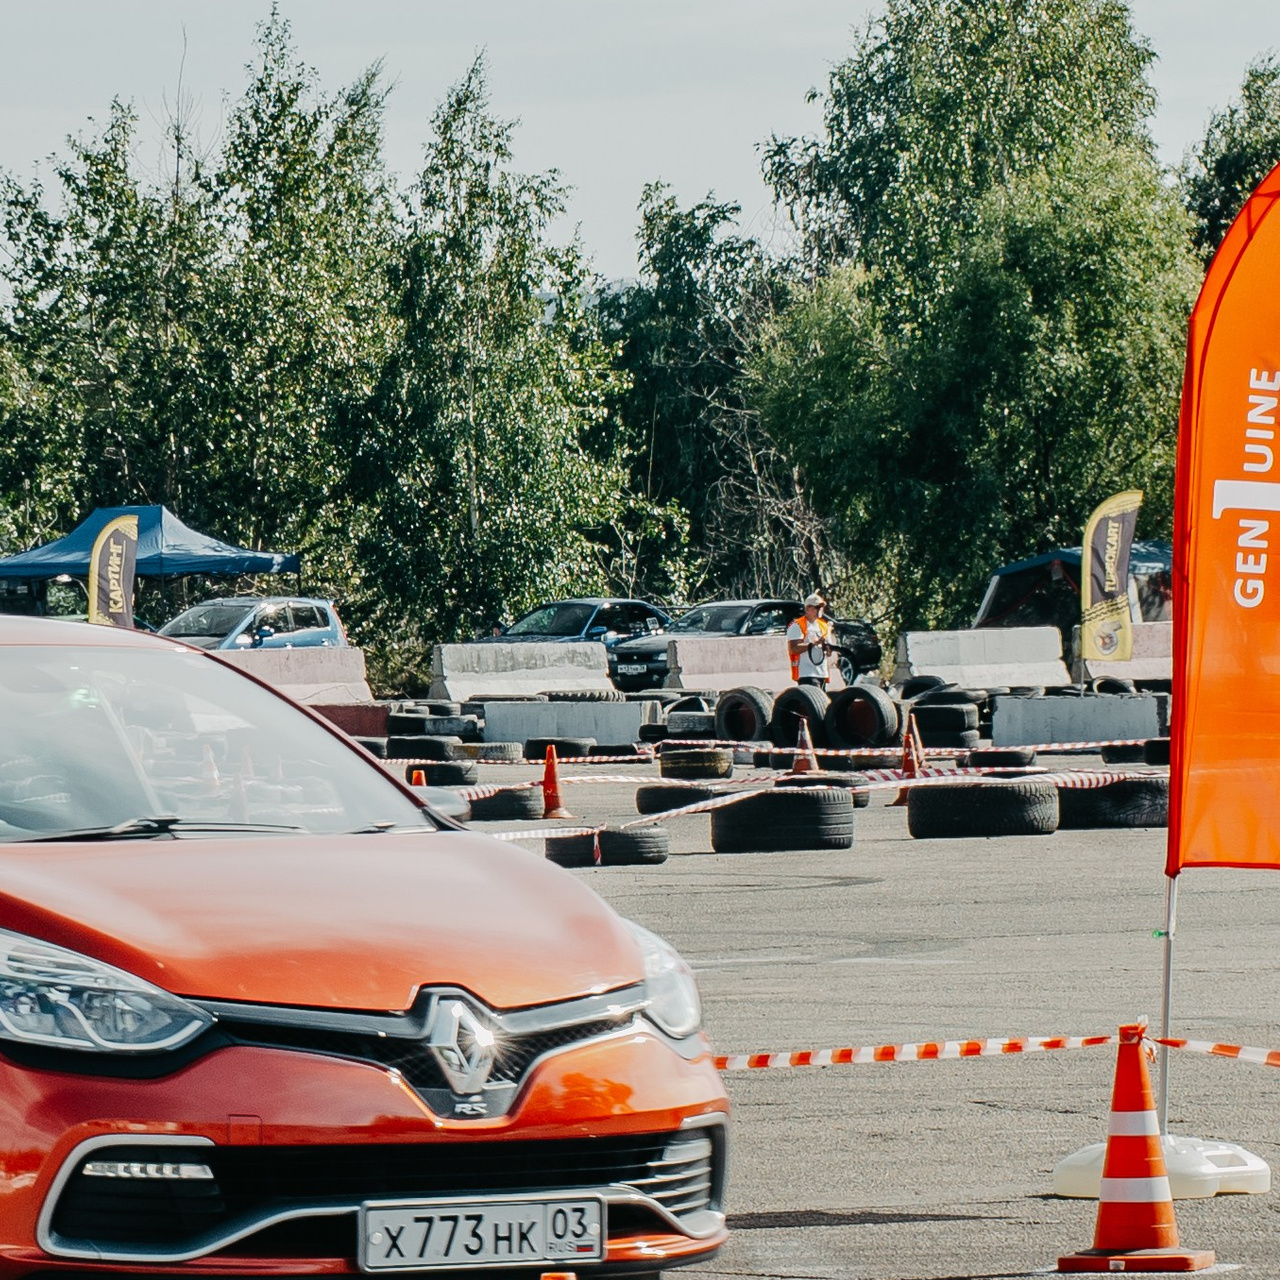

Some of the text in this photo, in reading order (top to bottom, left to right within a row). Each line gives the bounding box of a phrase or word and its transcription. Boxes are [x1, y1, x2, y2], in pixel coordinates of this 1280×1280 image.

[108, 538, 123, 613] КАРТИНГ
[454, 1103, 488, 1115] RS
[552, 1207, 587, 1239] 03
[548, 1241, 575, 1253] RUS
